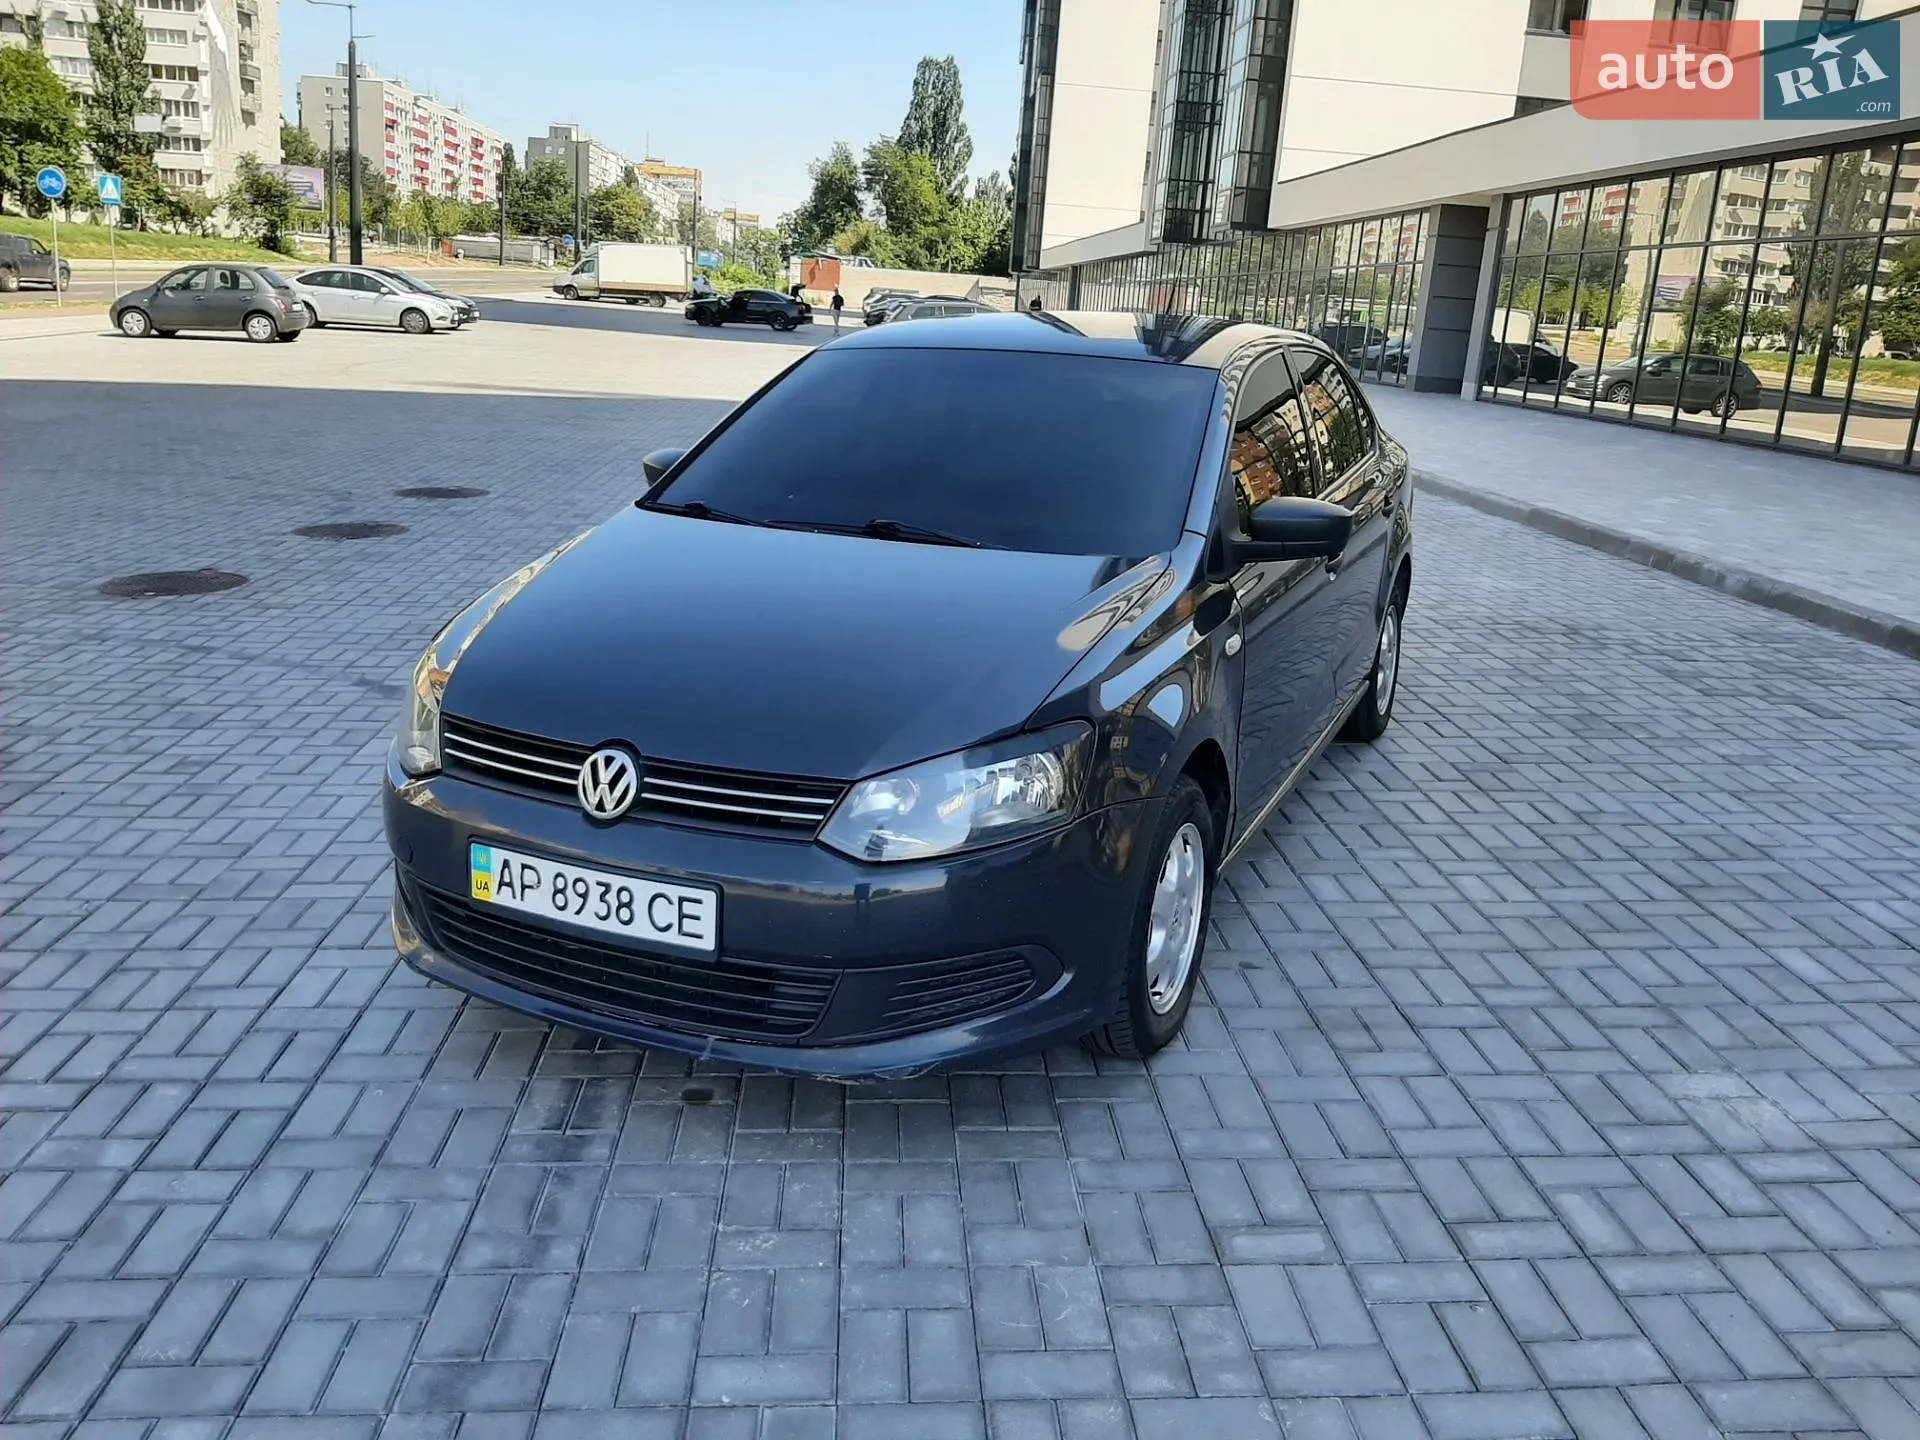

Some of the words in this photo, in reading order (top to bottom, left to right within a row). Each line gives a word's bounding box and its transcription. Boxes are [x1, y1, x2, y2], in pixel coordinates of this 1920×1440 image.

[475, 879, 490, 893] UA
[496, 858, 541, 902] AP
[552, 871, 635, 926] 8938
[648, 892, 705, 940] CE
